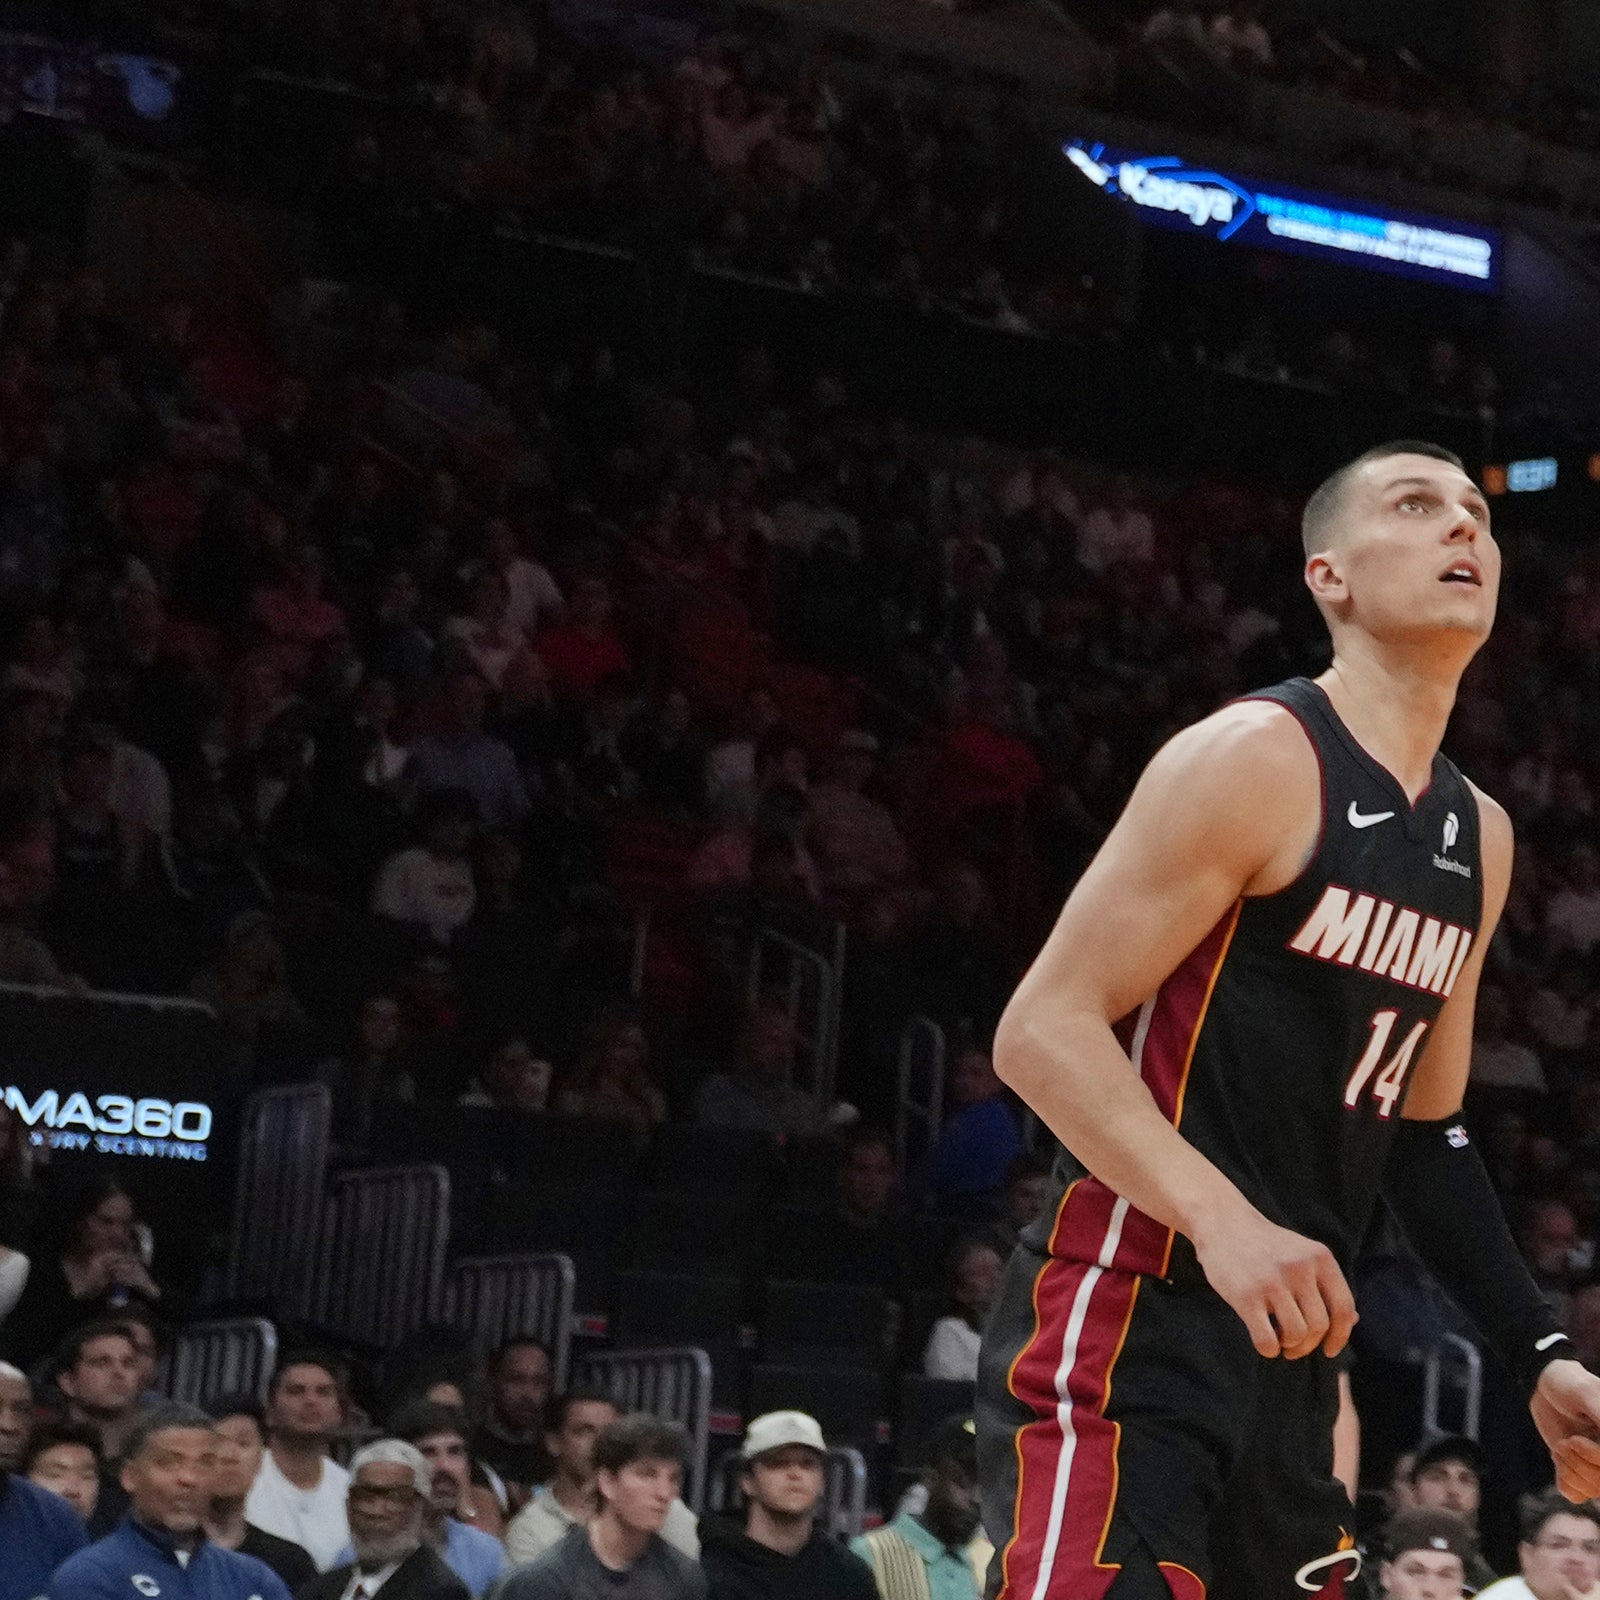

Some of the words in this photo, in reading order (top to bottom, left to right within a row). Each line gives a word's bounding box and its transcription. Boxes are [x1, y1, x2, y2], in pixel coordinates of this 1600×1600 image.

[1286, 883, 1474, 1000] MIAMI
[0, 1084, 213, 1141] MA360
[1345, 1008, 1430, 1120] 14
